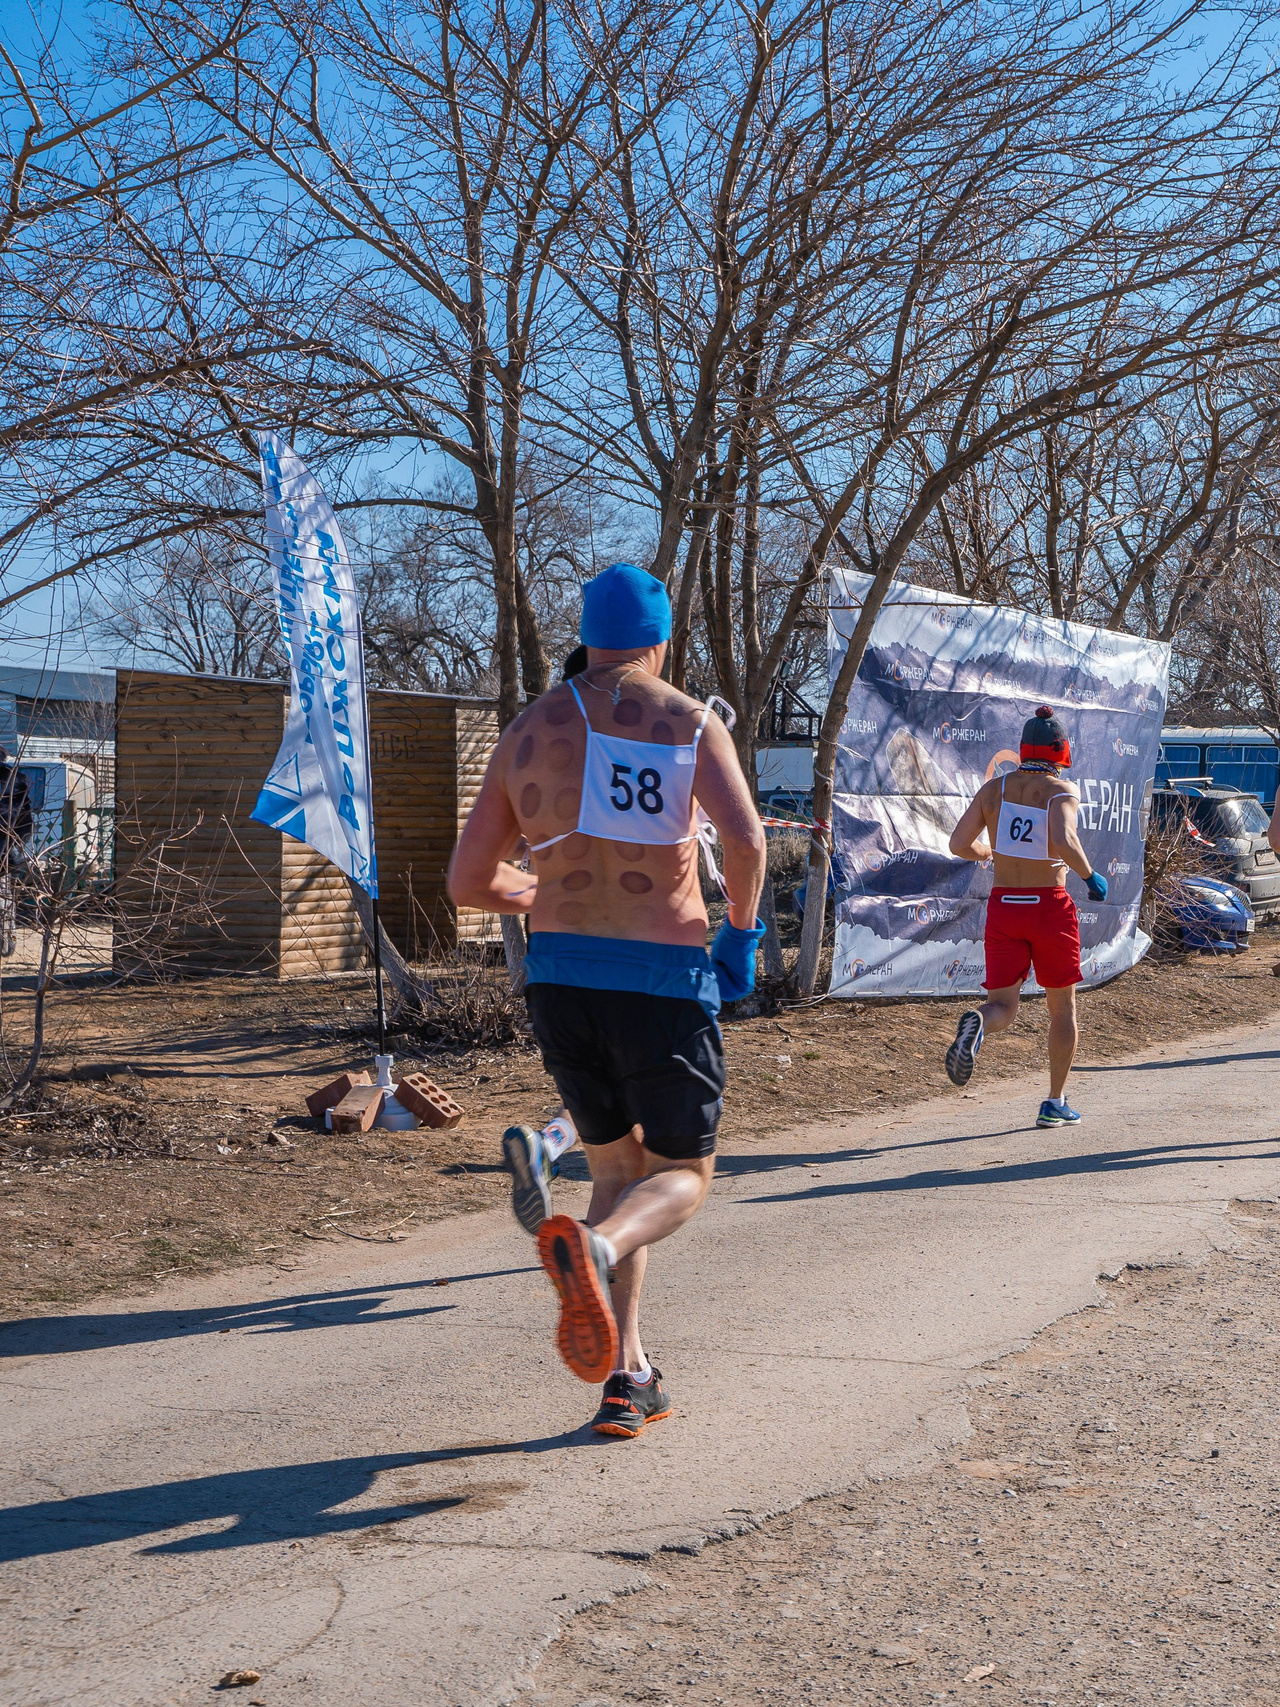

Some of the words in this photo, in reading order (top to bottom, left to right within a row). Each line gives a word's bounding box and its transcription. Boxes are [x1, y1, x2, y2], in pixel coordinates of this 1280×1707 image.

[931, 608, 973, 631] МОРЖЕРАН
[884, 659, 934, 681] МОРЖЕРАН
[932, 722, 986, 744] МОРЖЕРАН
[609, 763, 664, 815] 58
[1009, 816, 1033, 843] 62
